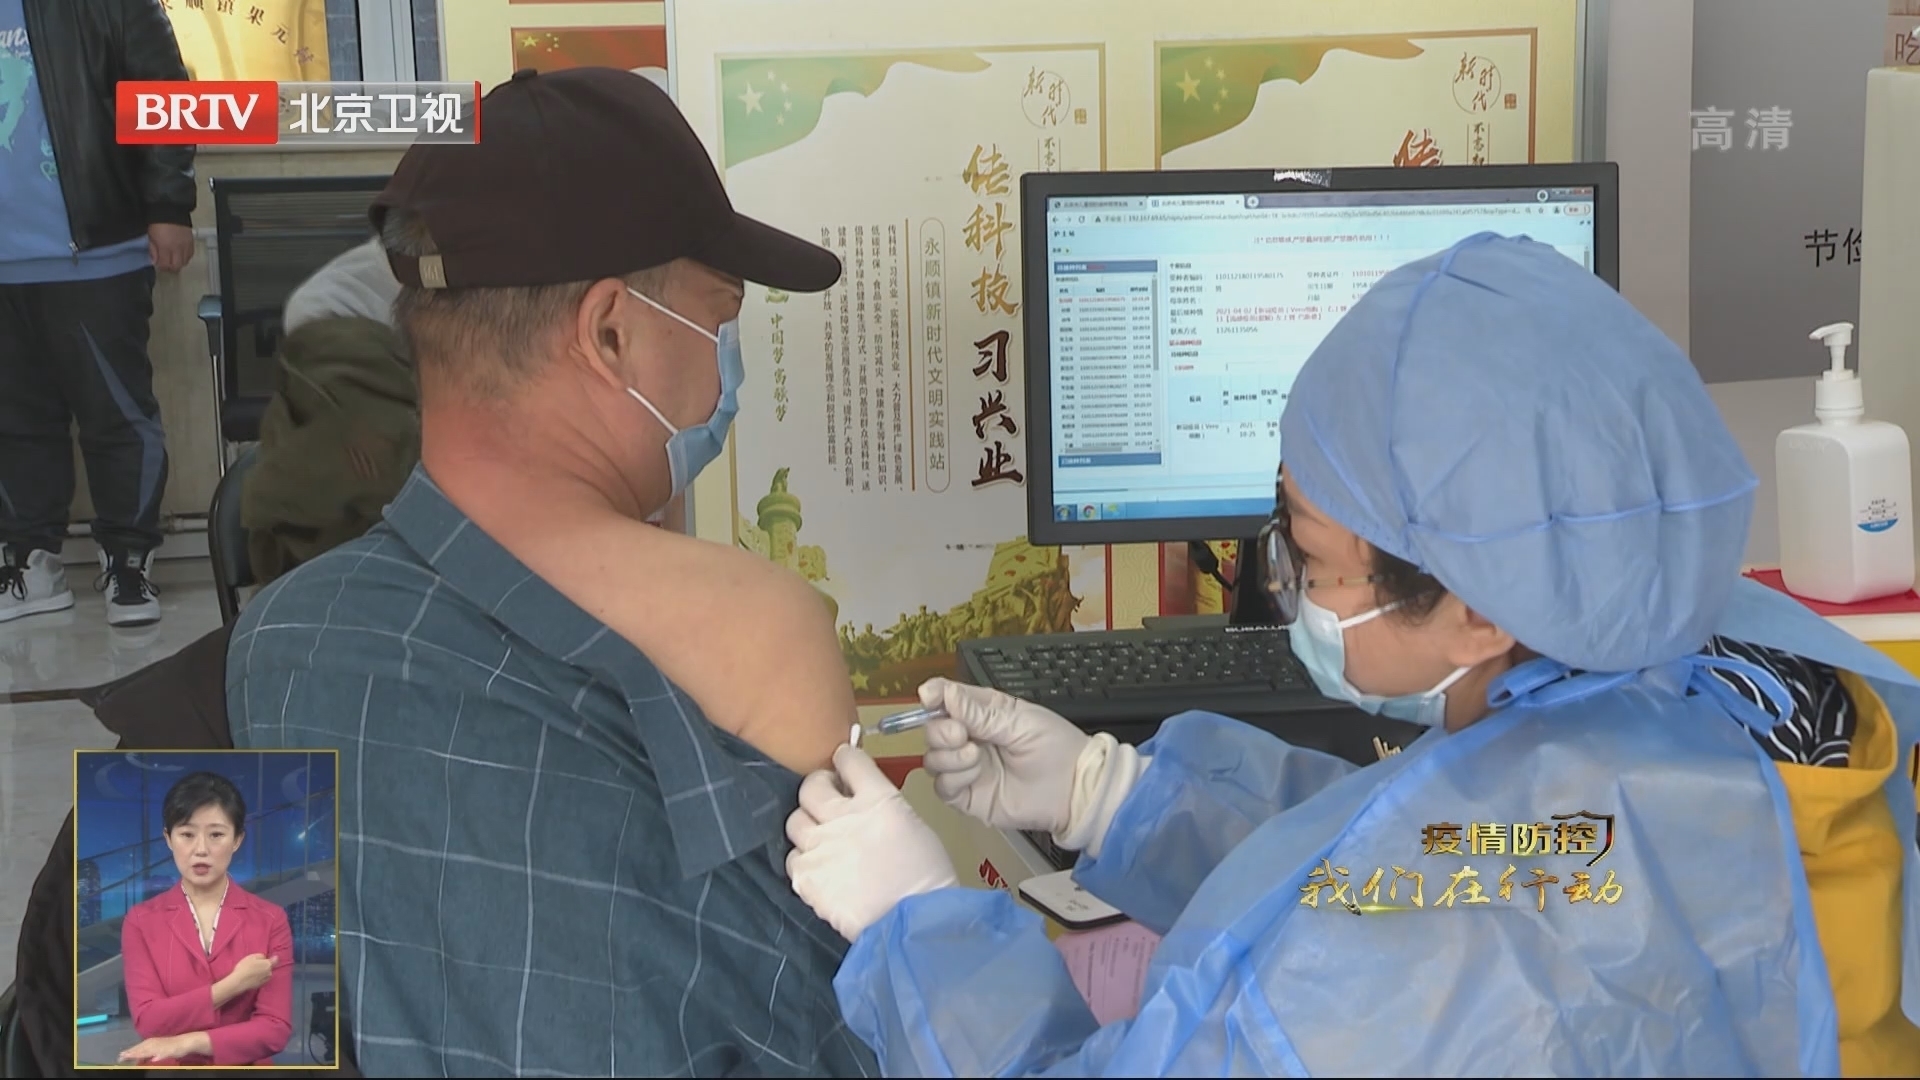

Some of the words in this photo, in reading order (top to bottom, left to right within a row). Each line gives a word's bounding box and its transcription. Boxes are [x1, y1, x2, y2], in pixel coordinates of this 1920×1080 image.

[924, 237, 945, 471] 永顺镇新时代文明实践站
[971, 329, 1024, 487] 习兴业
